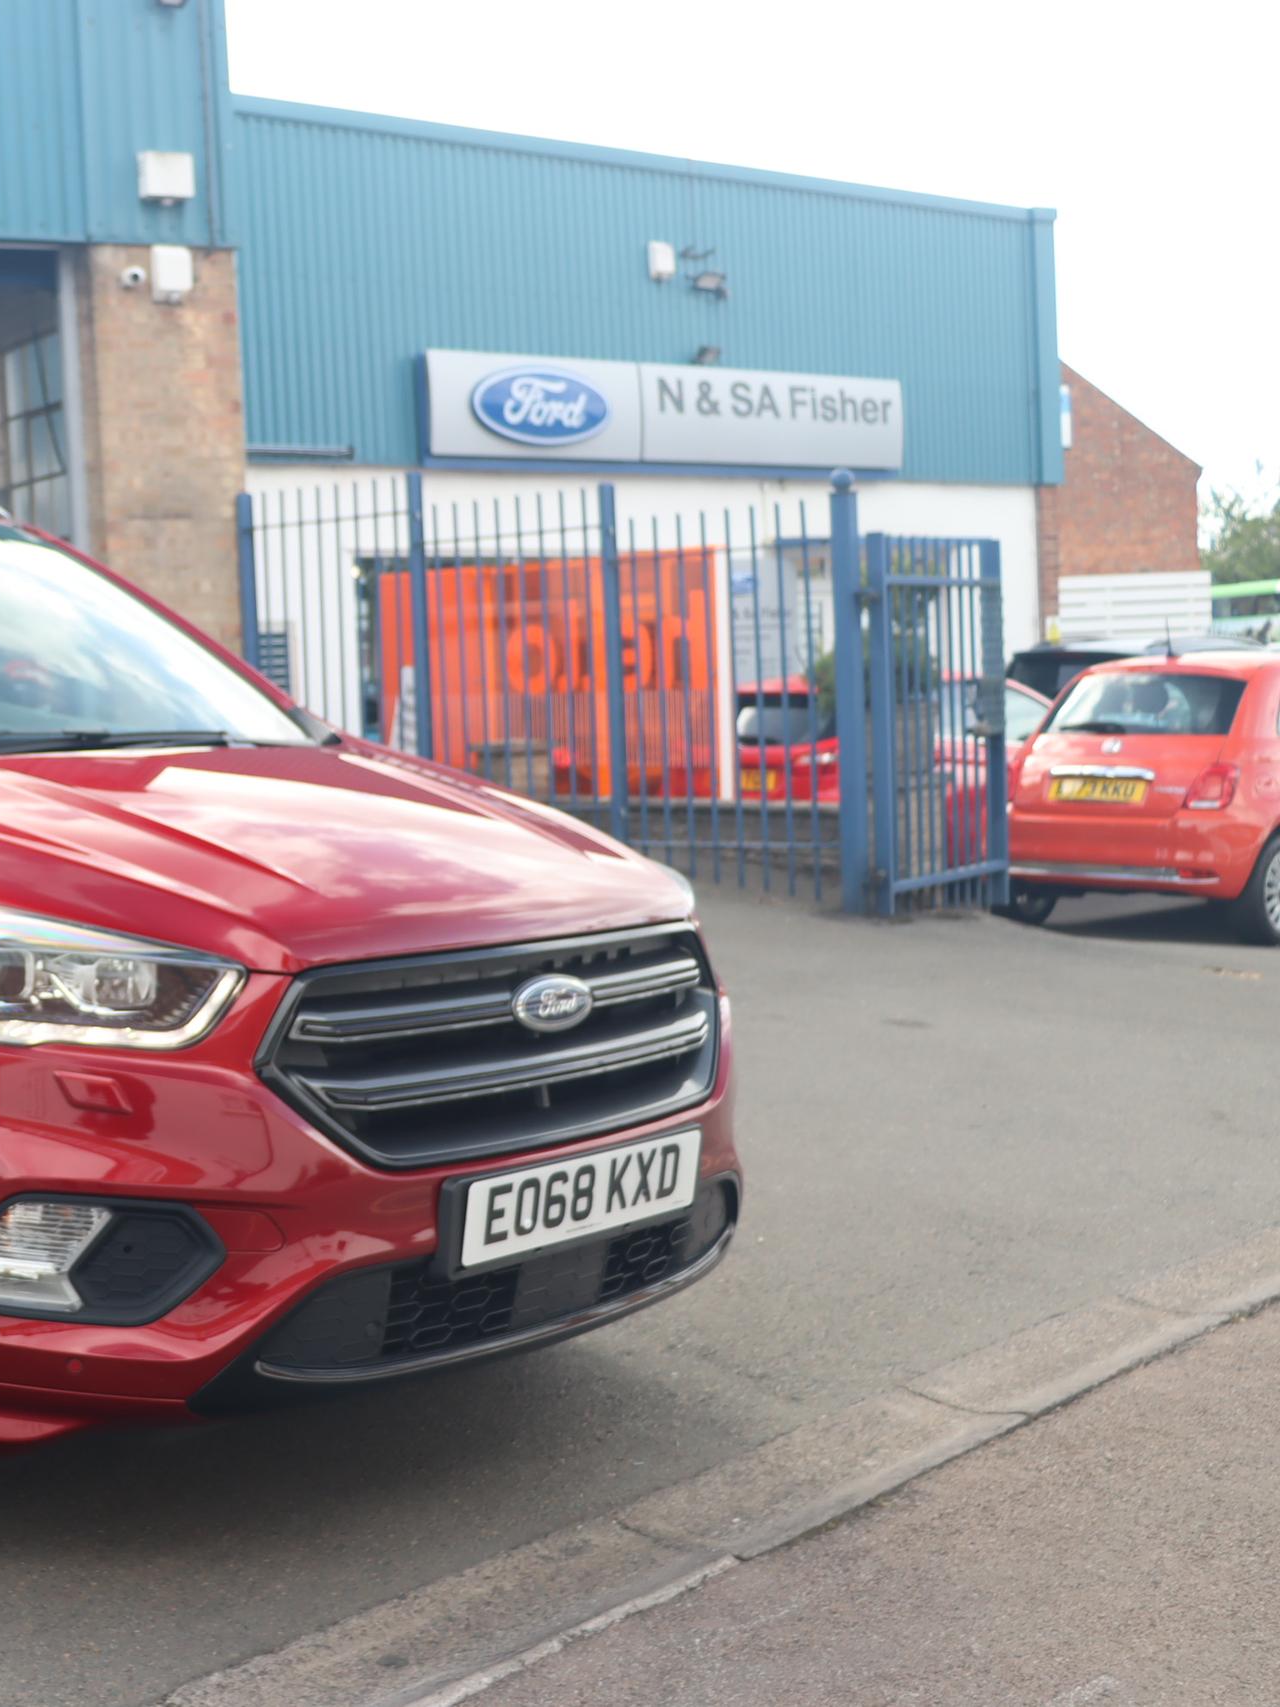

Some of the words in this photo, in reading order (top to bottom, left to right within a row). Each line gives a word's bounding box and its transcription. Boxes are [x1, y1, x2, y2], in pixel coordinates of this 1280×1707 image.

[503, 374, 587, 429] Ford
[657, 377, 686, 415] N
[697, 381, 723, 416] &
[730, 382, 782, 420] SA
[789, 386, 893, 425] Fisher
[538, 987, 578, 1018] Ford
[605, 1142, 681, 1214] KXD
